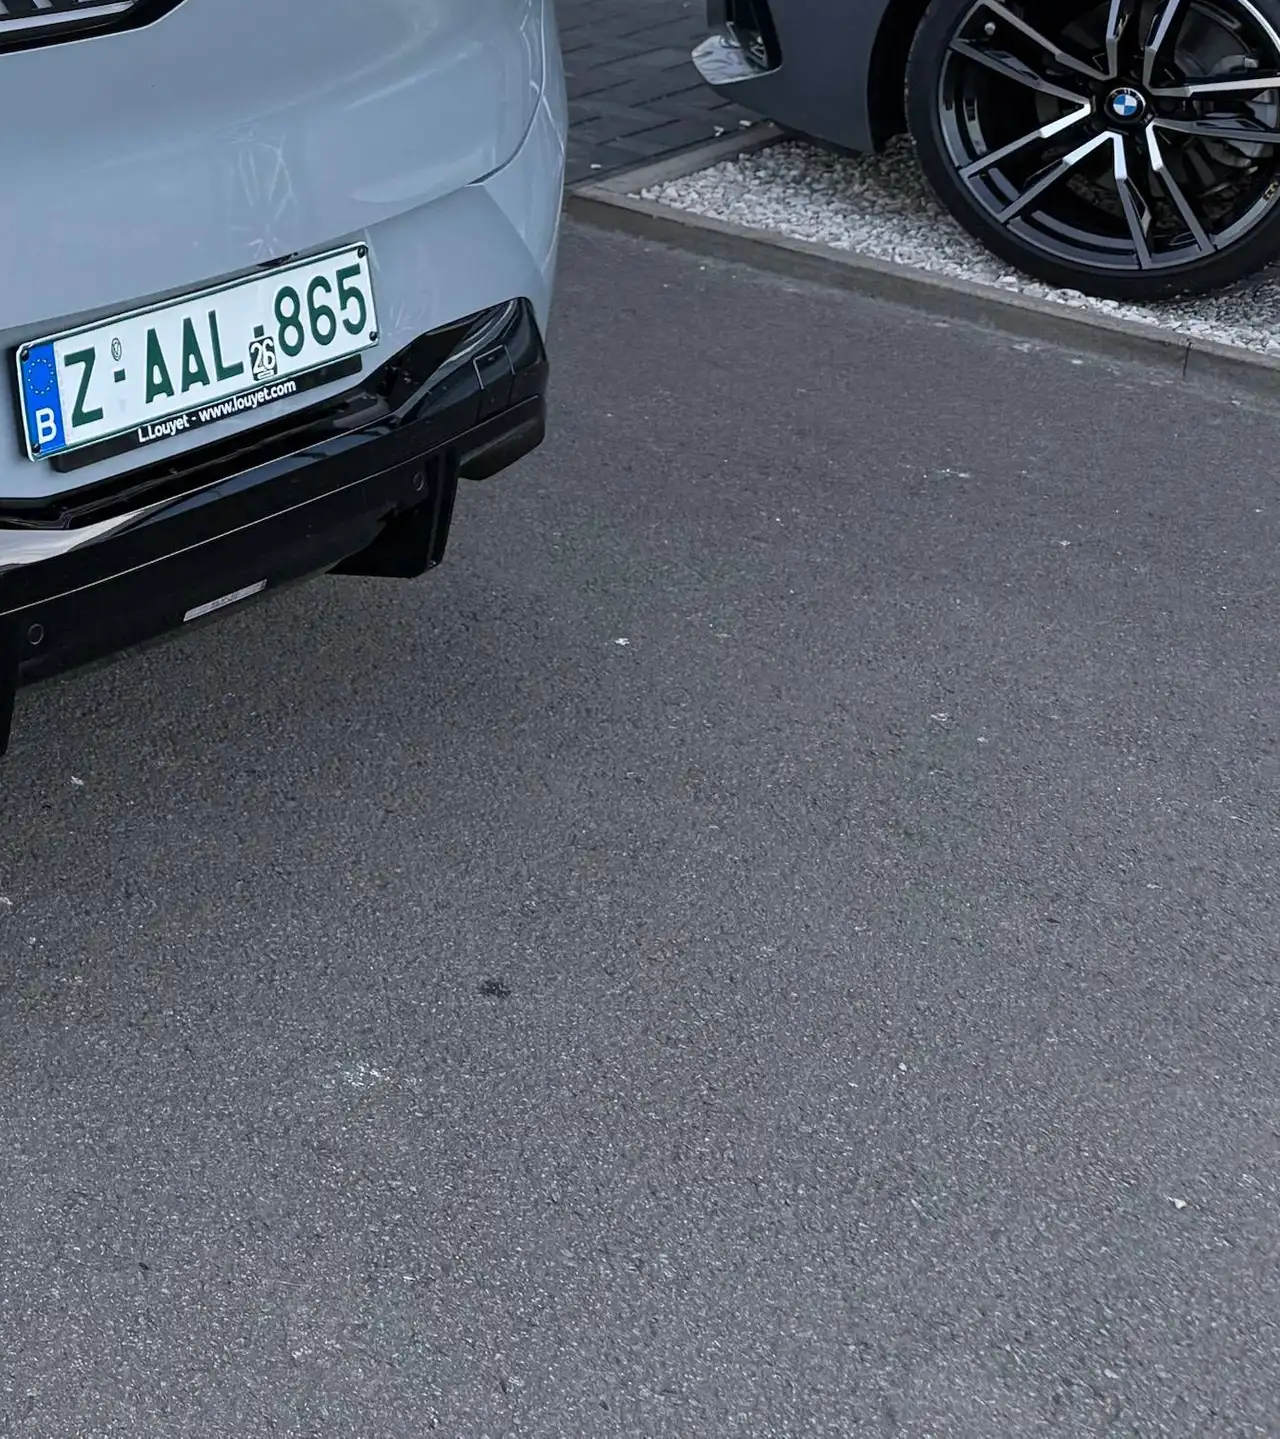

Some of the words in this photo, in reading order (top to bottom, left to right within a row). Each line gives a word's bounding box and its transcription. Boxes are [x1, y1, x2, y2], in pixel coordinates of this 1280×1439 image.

[250, 338, 276, 374] 26
[36, 407, 57, 443] B
[137, 414, 190, 443] L.Louyet
[198, 380, 297, 423] www.louyet.com
